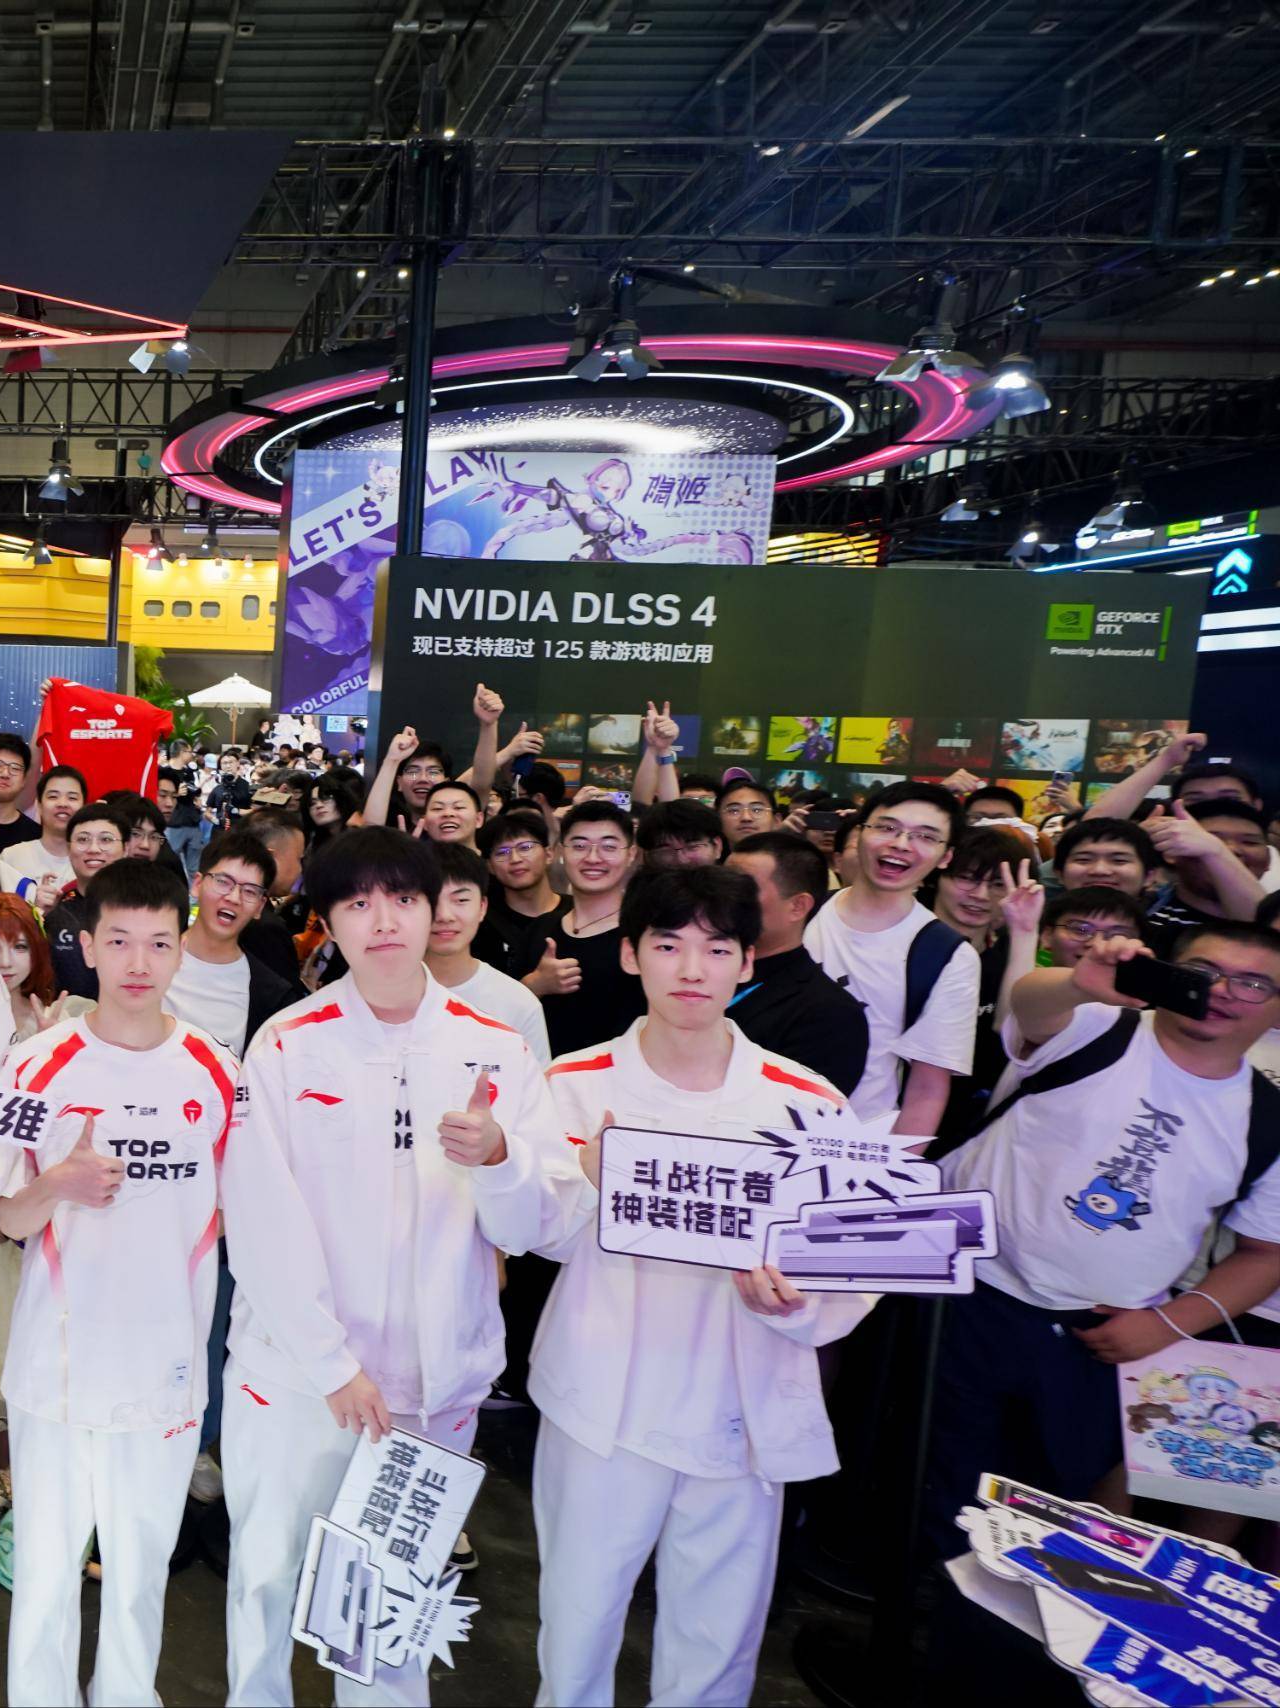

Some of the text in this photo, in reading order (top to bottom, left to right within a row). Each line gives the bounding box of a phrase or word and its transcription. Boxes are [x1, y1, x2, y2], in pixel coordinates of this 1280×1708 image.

[289, 499, 383, 567] LET'S
[413, 587, 718, 627] NVIDIA DLSS 4
[1096, 611, 1161, 623] GEFORCE
[1095, 623, 1124, 635] RTX
[412, 636, 714, 663] 现已支持超过 125 款游戏和应用
[1049, 646, 1095, 657] Powering
[1096, 648, 1143, 657] Advanced
[86, 719, 117, 729] TOP
[70, 729, 133, 739] ESPORTS
[633, 1158, 777, 1206] 斗战行者
[610, 1190, 756, 1242] 神装搭配
